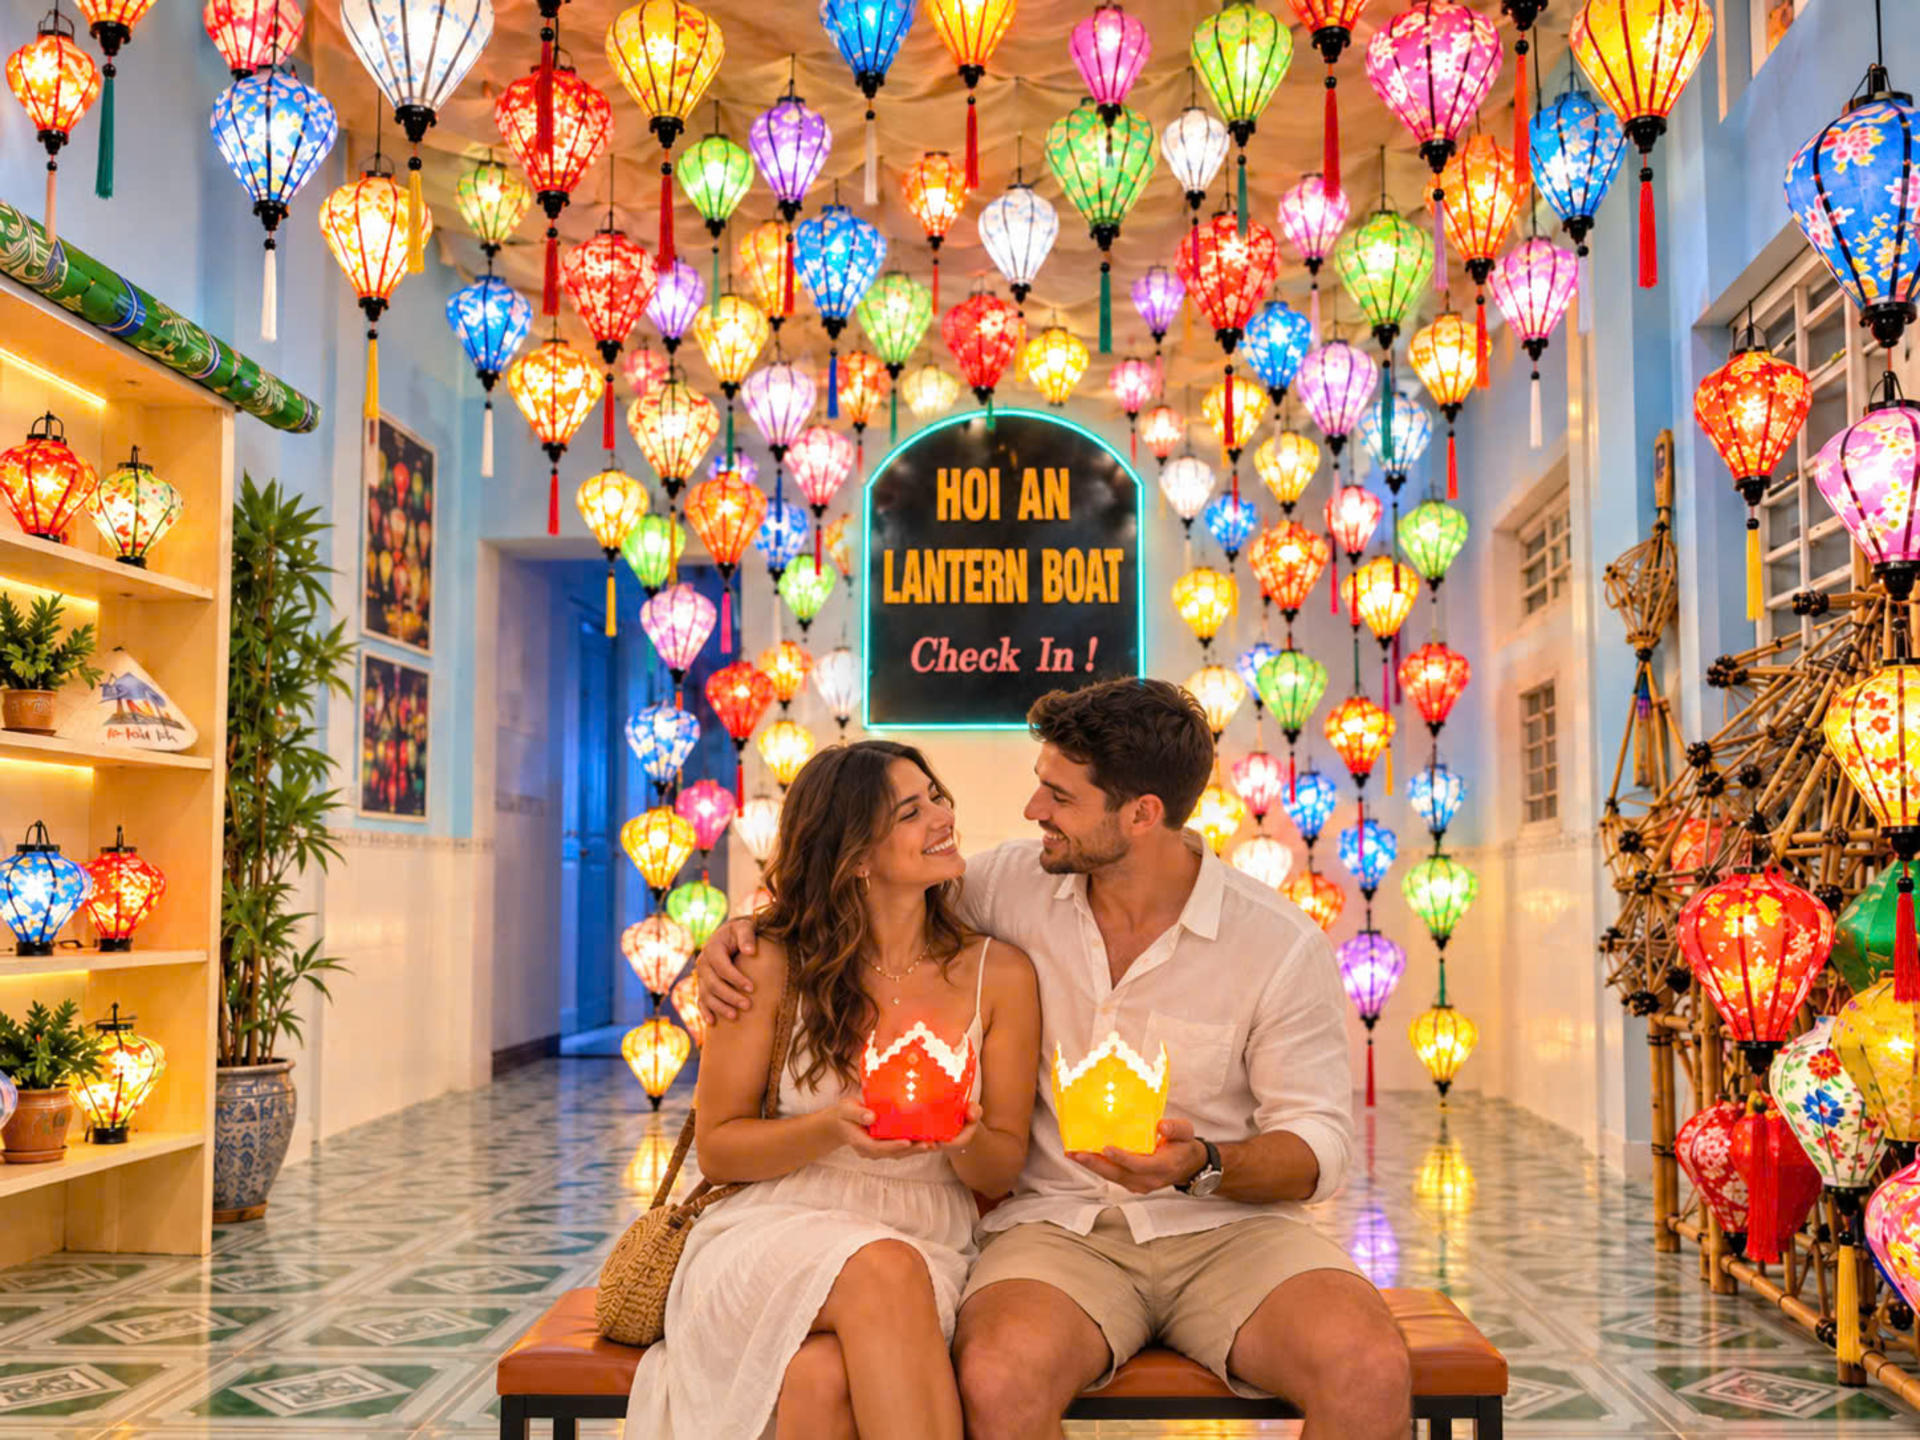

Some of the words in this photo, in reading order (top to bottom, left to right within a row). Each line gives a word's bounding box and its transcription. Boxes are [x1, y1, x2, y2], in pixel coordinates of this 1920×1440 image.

[937, 467, 1000, 521] HOI
[1017, 467, 1071, 521] AN
[883, 549, 1029, 604] LANTERN
[1041, 547, 1124, 604] BOAT
[911, 637, 1021, 673] Check
